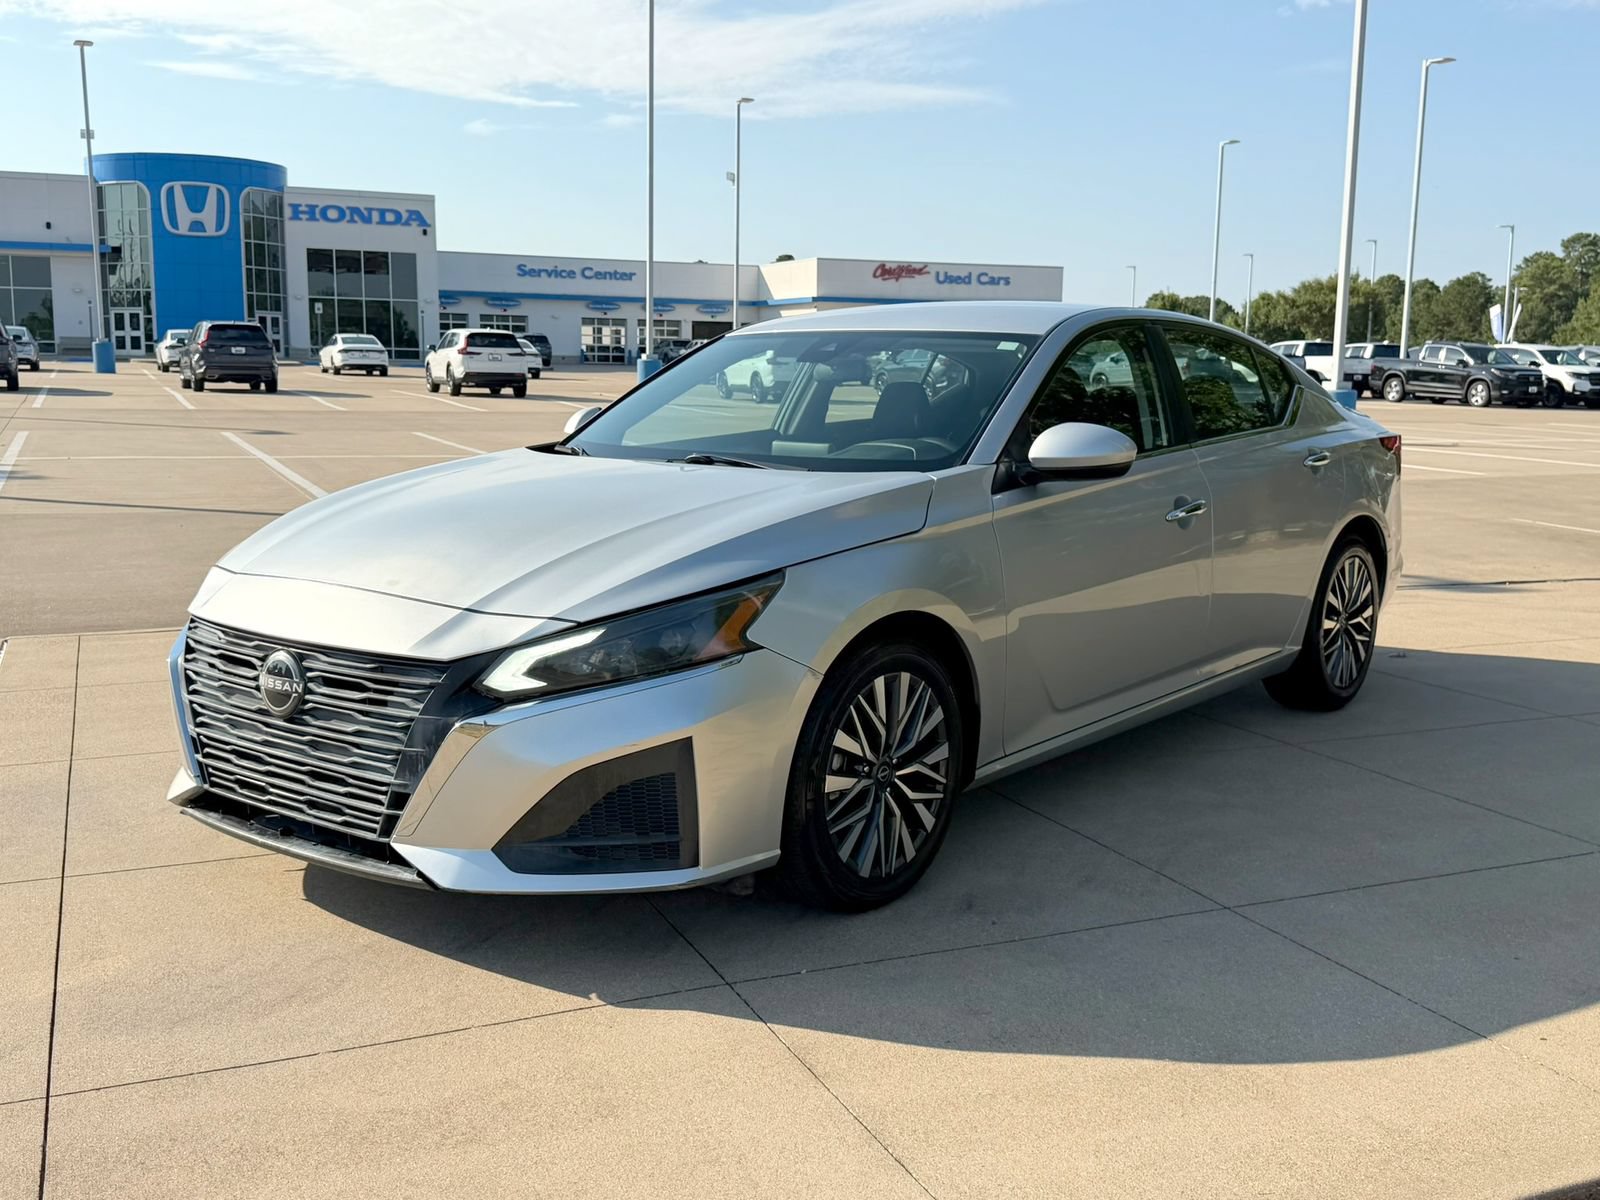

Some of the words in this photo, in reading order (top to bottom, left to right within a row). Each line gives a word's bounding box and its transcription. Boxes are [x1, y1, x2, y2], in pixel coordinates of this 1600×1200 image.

[287, 202, 432, 228] HONDA
[516, 263, 577, 279] Service
[580, 266, 637, 281] Center
[935, 270, 972, 285] Used
[976, 272, 1011, 286] Cars
[259, 674, 303, 693] NISSAN
